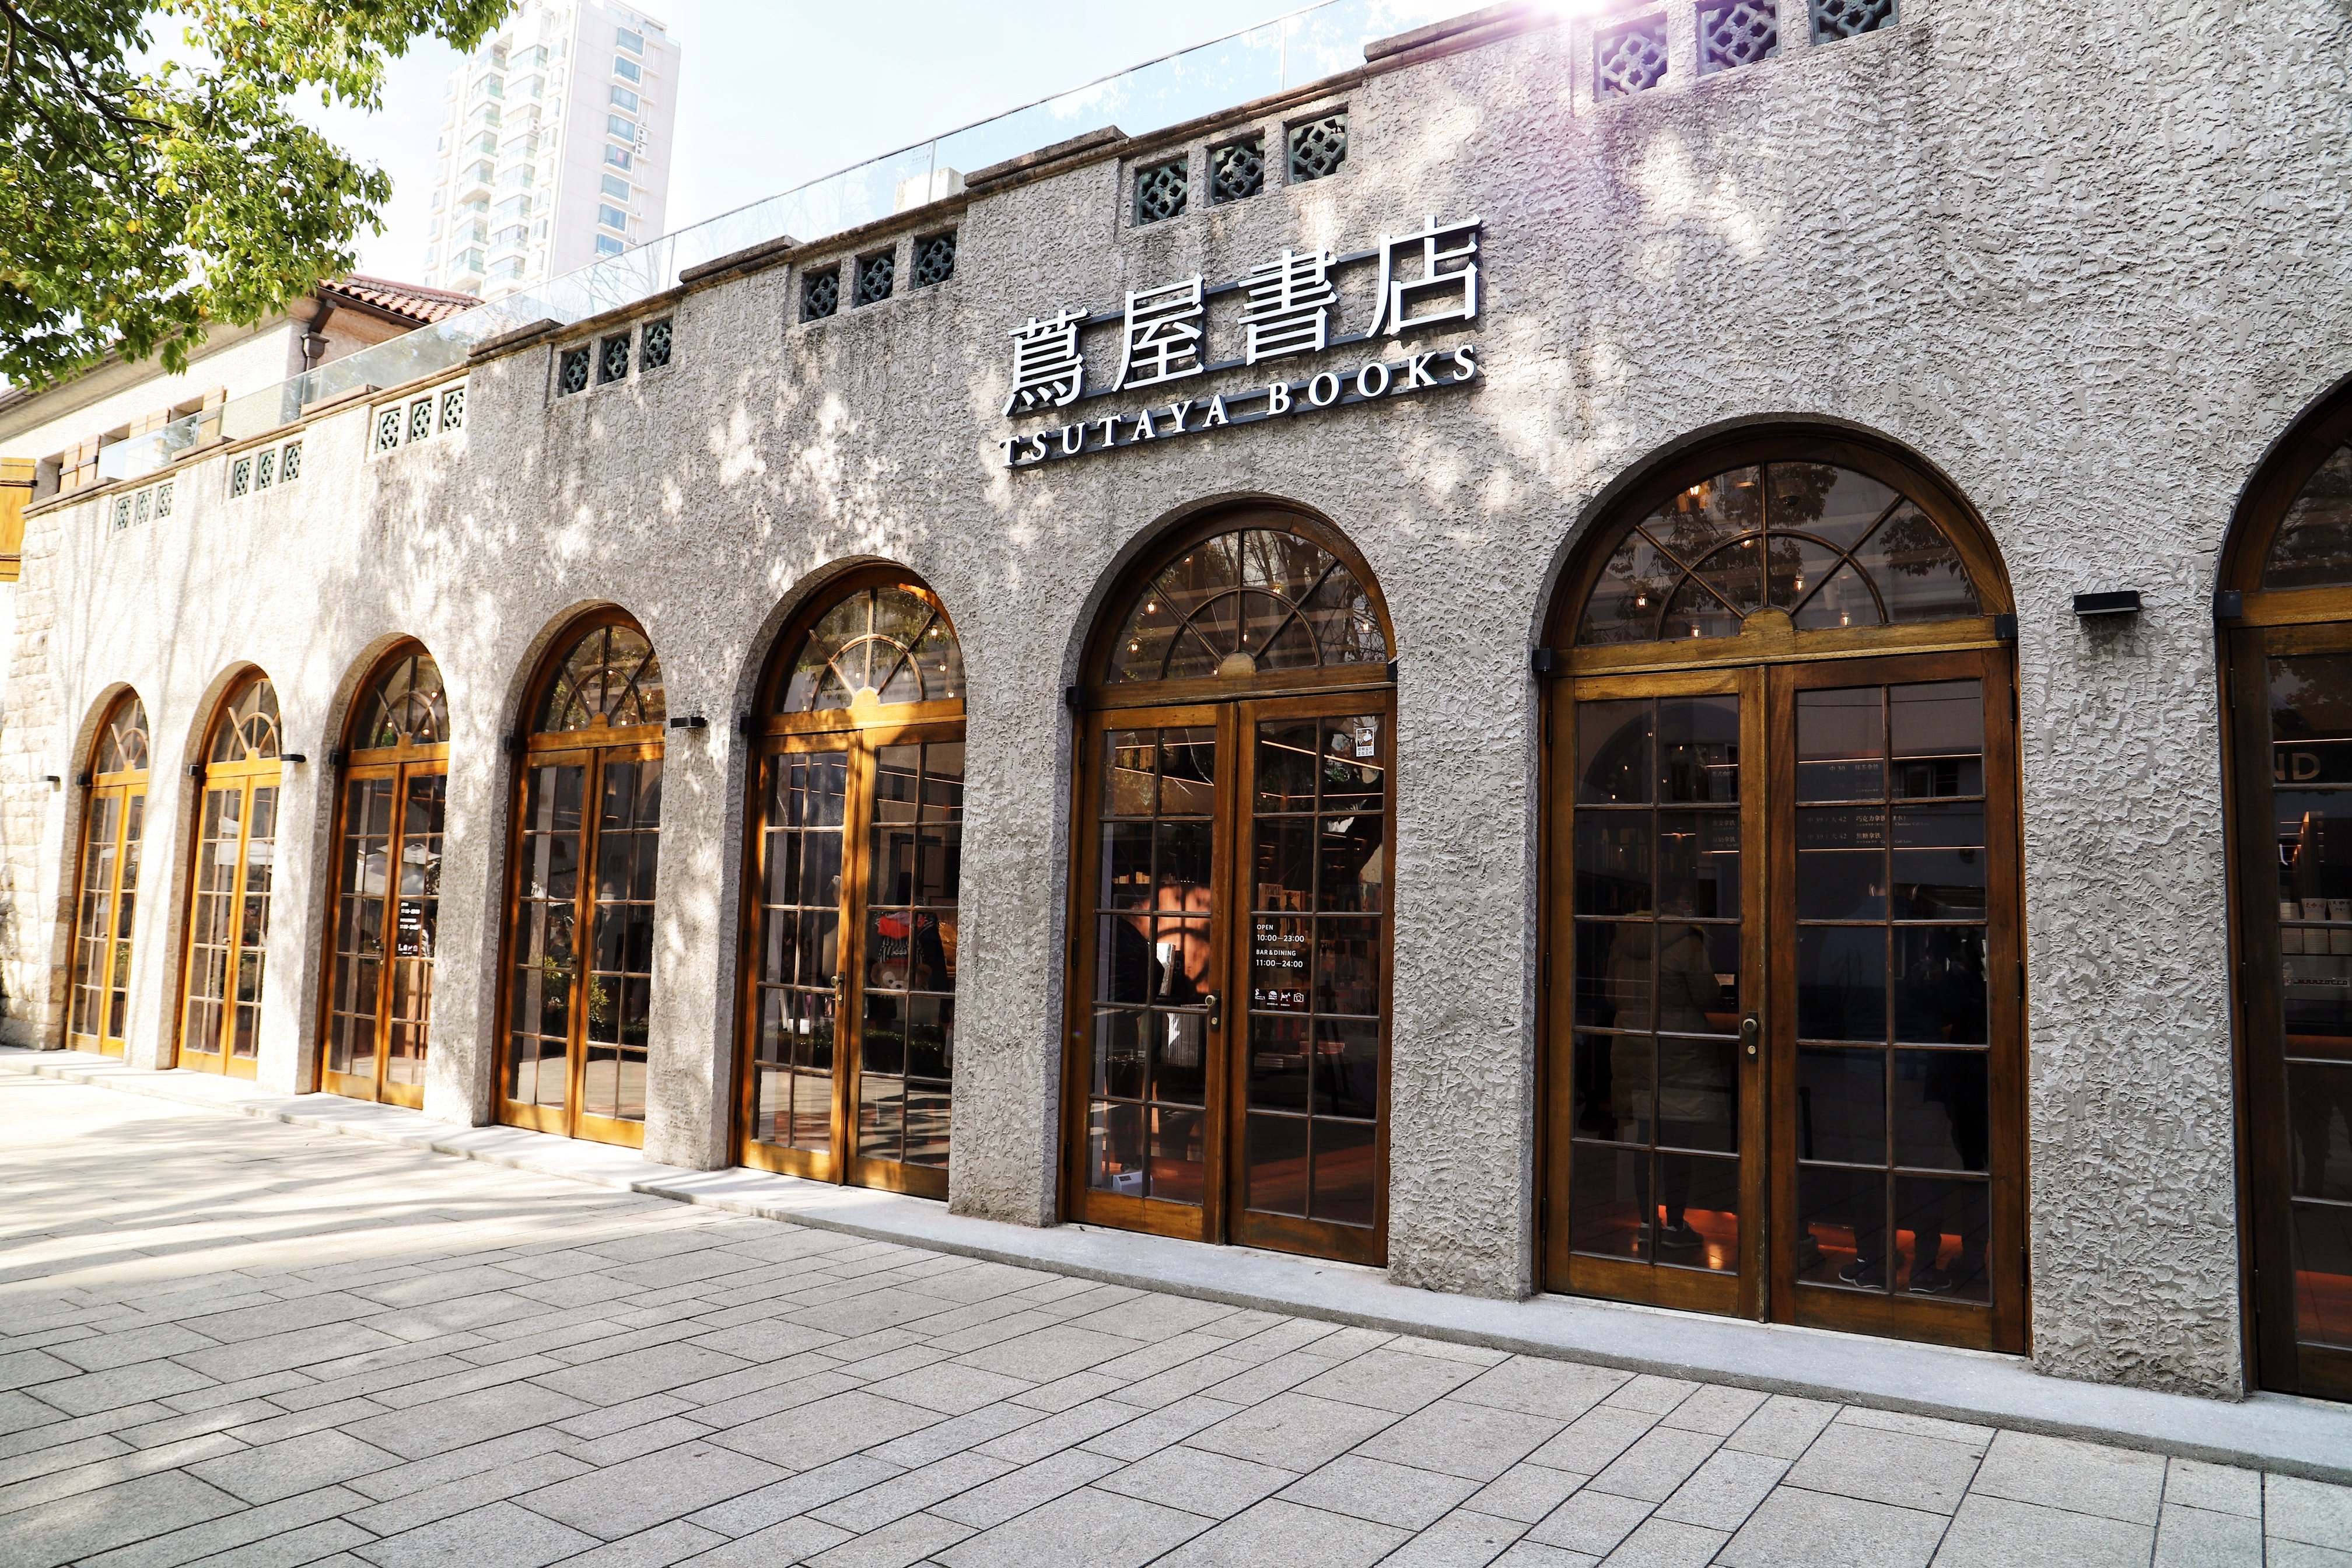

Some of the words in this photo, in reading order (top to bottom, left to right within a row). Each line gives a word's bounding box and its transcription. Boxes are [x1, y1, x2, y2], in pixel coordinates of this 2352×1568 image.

[1001, 213, 1483, 416] 蔦屋書店
[998, 394, 1229, 467] TSUTAYA
[1266, 344, 1478, 416] BOOKS
